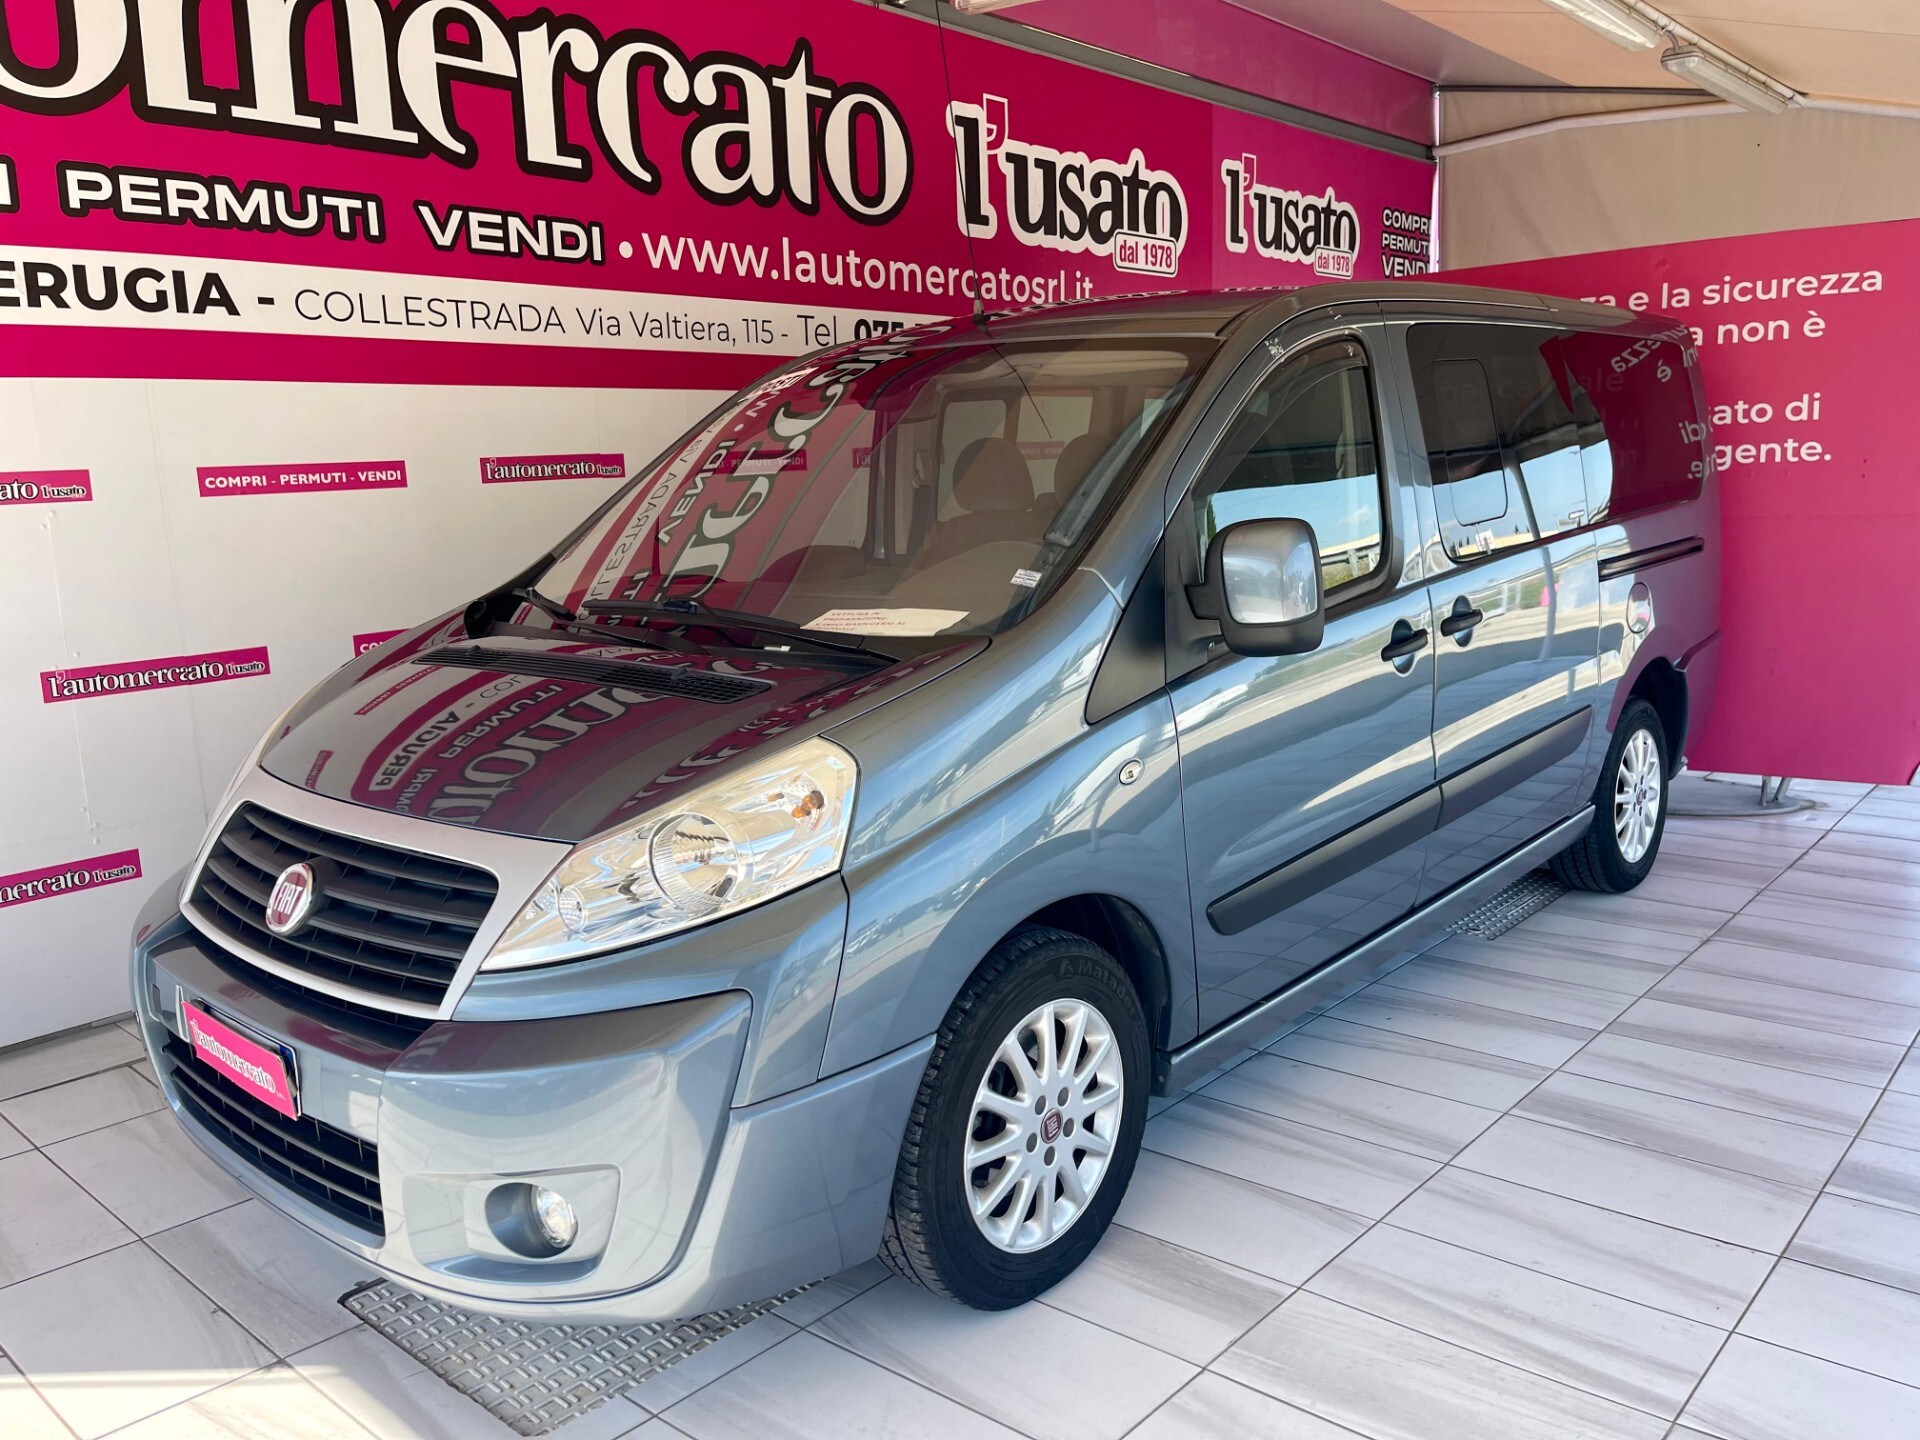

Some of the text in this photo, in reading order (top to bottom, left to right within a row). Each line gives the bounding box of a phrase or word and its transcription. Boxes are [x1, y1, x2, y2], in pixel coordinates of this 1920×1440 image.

[66, 169, 381, 236] PERMUTI
[418, 205, 602, 261] VENDI
[641, 232, 1094, 303] www.lautomercatosrl.it
[1119, 238, 1173, 269] dal 1978
[1317, 251, 1350, 273] dal 1978
[1628, 291, 1649, 311] e
[1661, 282, 1690, 309] la
[1702, 269, 1883, 306] sicurezza
[295, 288, 567, 334] COLLESTRADA
[576, 307, 621, 336] Via
[629, 311, 738, 347] Valtiera,
[742, 318, 774, 344] 115
[1717, 319, 1789, 346] non
[1803, 310, 1826, 338] è
[1785, 392, 1821, 421] di
[205, 476, 267, 489] COMPRI
[280, 472, 347, 485] PERMUTI
[358, 470, 402, 482] VENDI
[485, 458, 596, 480] l'automercato
[274, 881, 303, 915] FIAT
